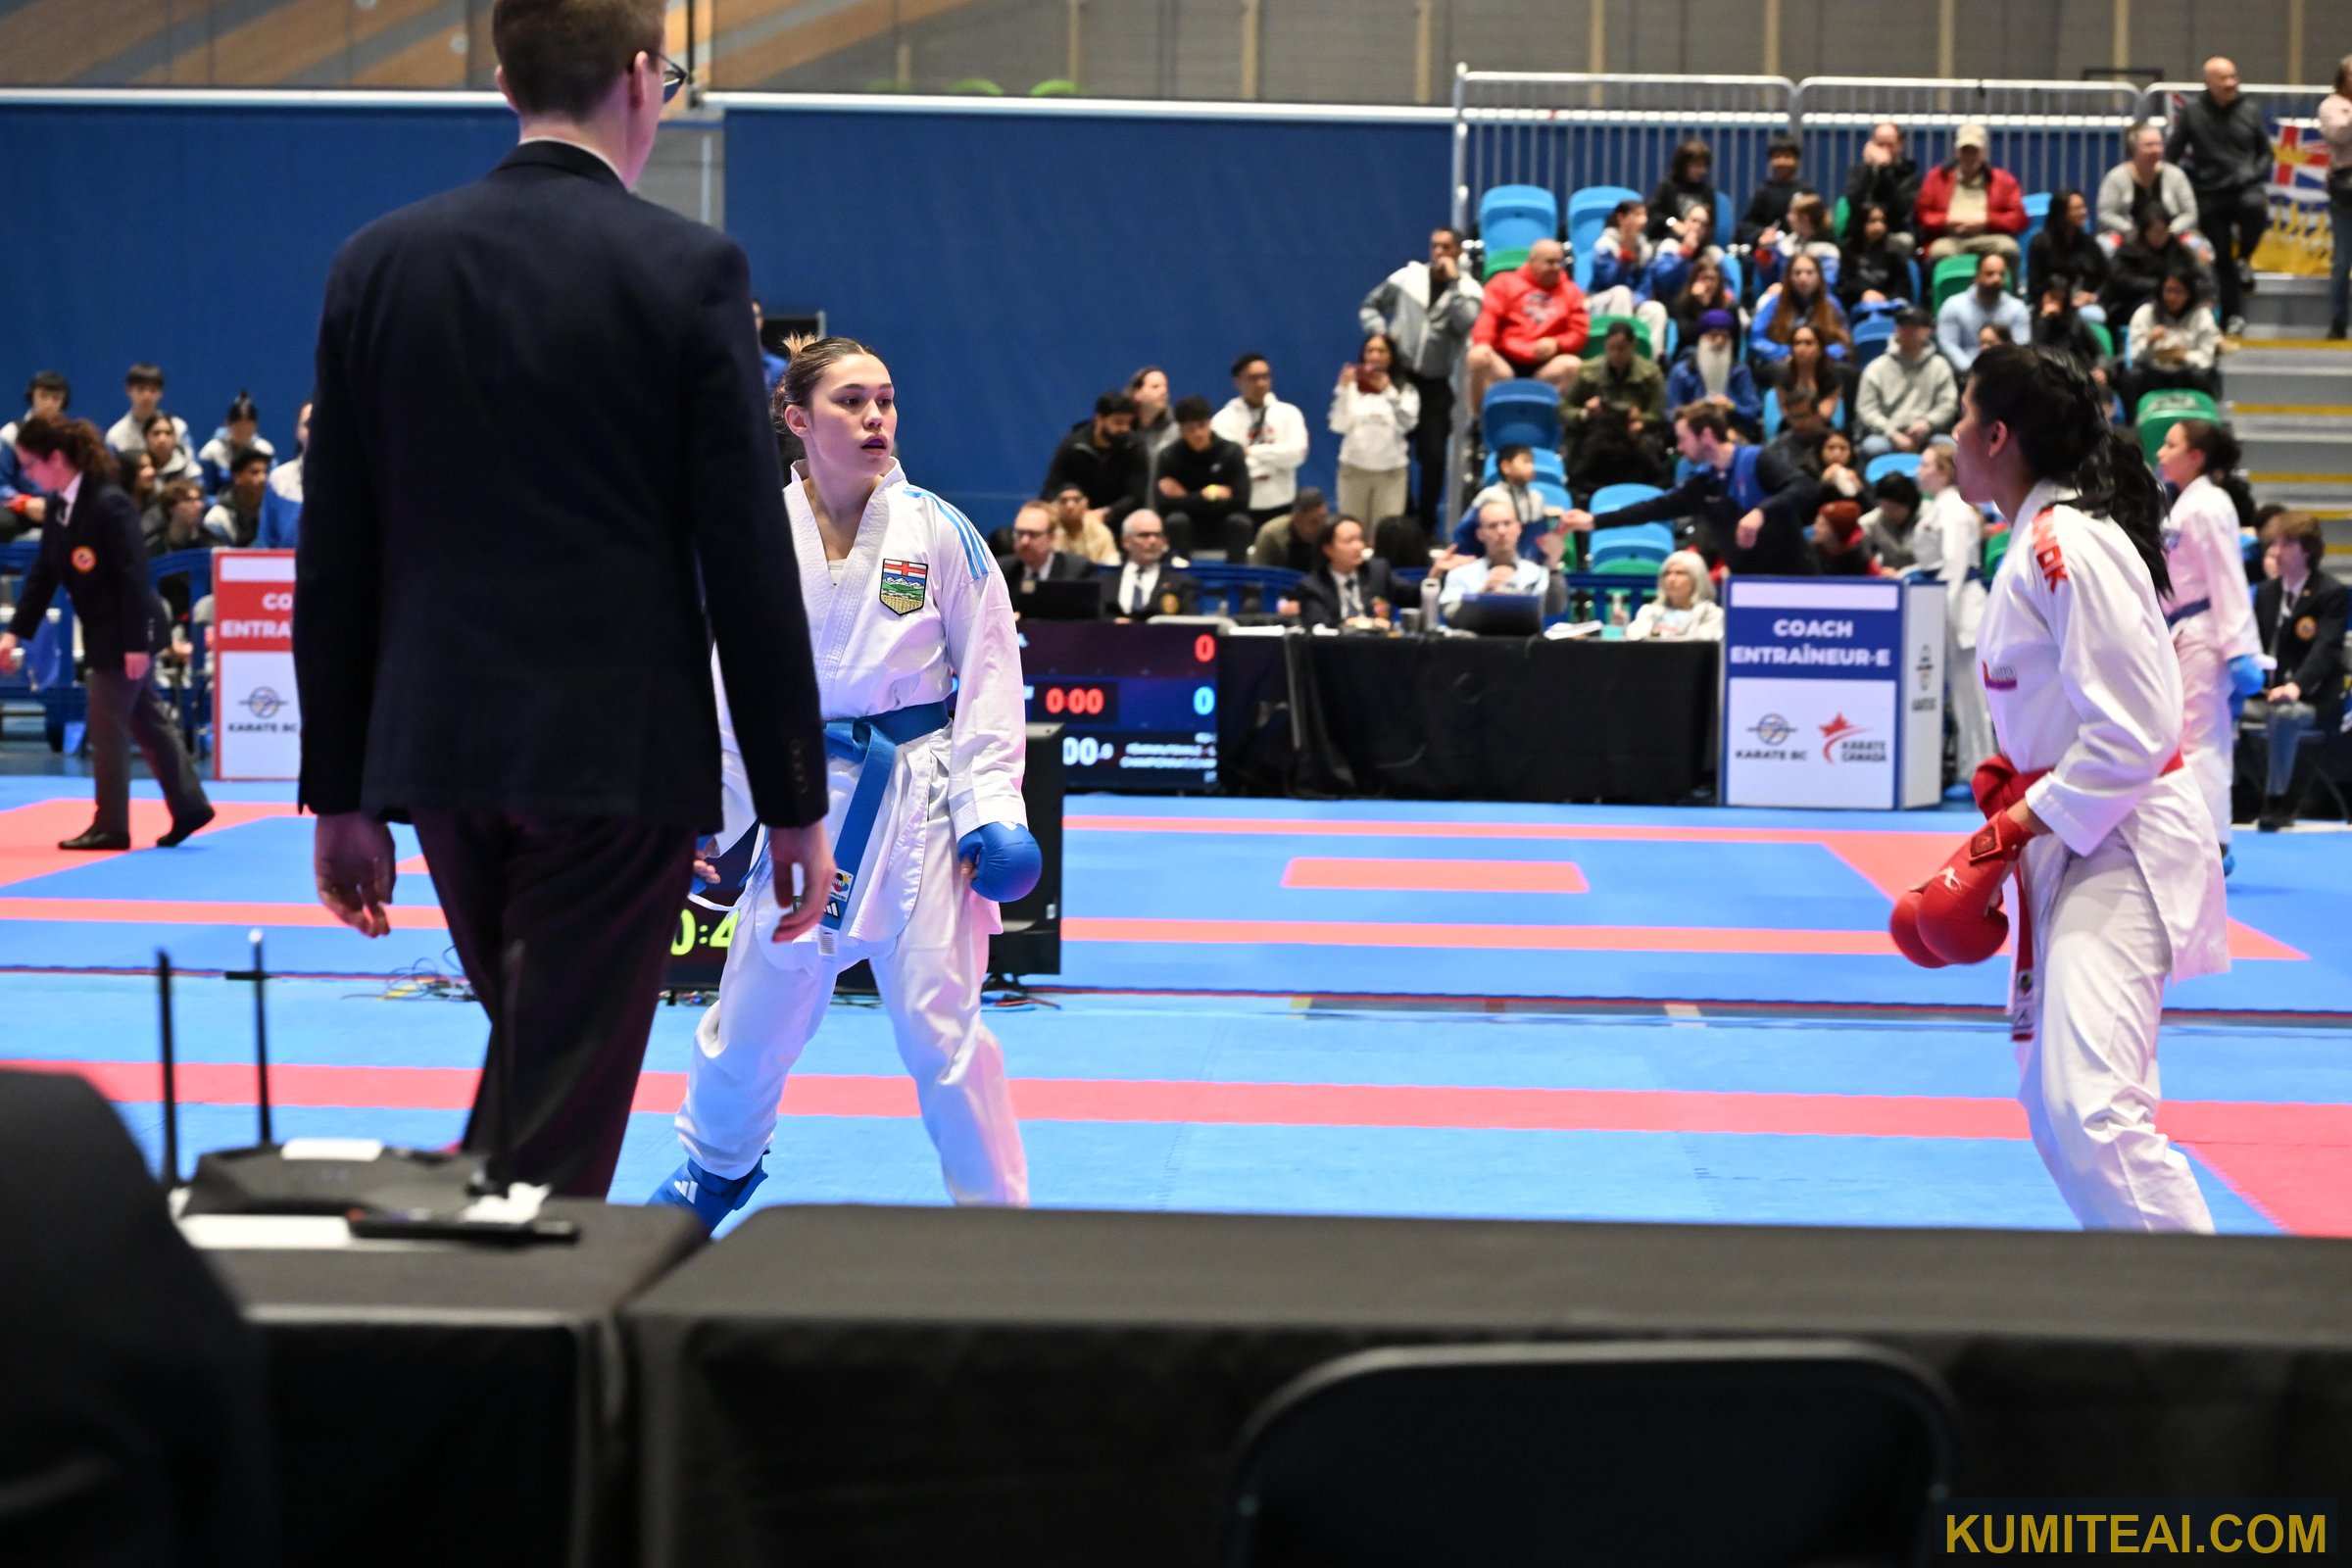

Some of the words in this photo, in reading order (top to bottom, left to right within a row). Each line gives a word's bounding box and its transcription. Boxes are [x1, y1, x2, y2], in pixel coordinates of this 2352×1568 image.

[220, 618, 292, 638] ENTRA
[1773, 619, 1853, 638] COACH
[1195, 634, 1215, 662] 0
[1194, 686, 1215, 715] 0
[1735, 750, 1787, 760] KARATE
